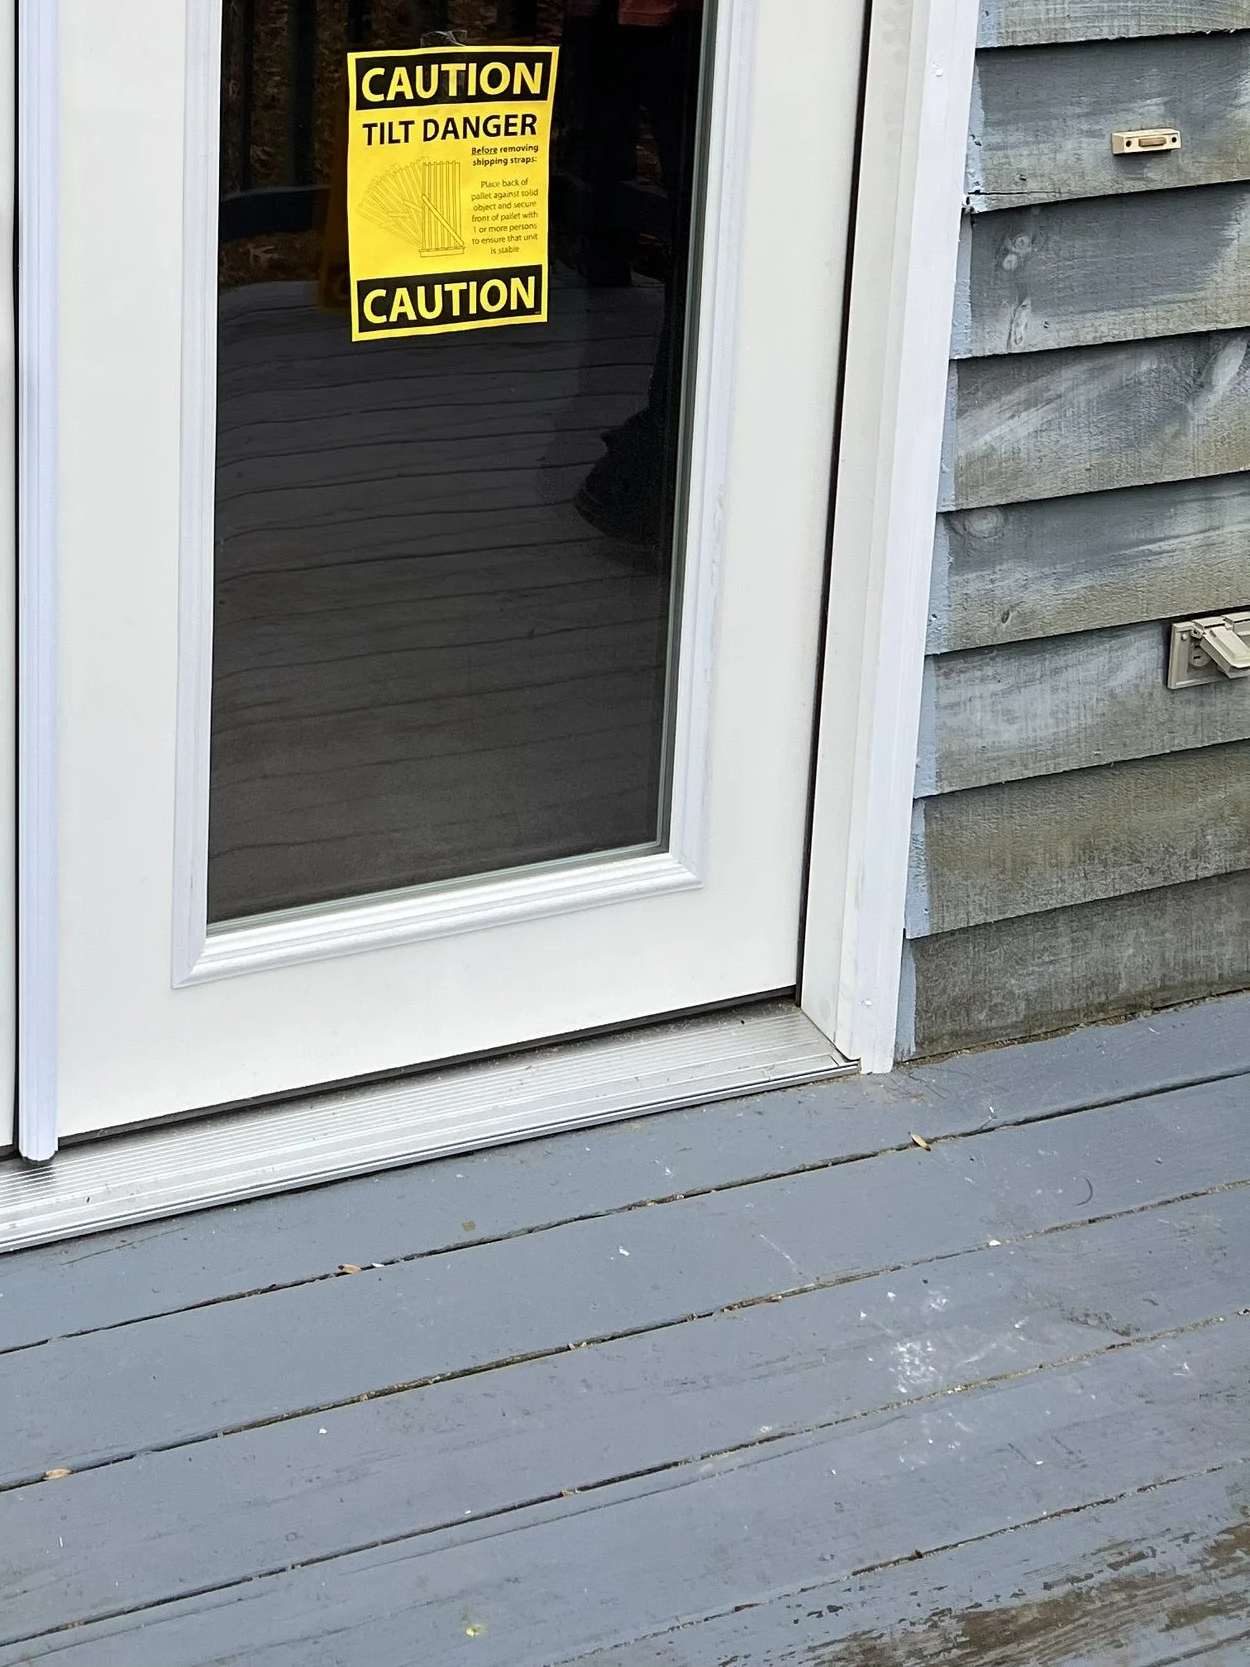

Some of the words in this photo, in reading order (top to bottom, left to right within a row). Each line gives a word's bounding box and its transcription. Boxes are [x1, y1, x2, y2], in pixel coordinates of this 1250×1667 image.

[361, 62, 543, 102] CAUTION
[362, 120, 415, 146] TILT
[423, 114, 537, 142] DANGER
[471, 146, 498, 156] Before
[500, 144, 539, 153] removing
[473, 158, 508, 167] shipping
[481, 180, 501, 188] Place
[502, 179, 519, 187] back
[471, 192, 491, 202] pallet
[494, 190, 520, 200] against
[521, 189, 538, 197] solid
[473, 204, 496, 212] object
[501, 212, 520, 222] pallet
[522, 211, 538, 219] with
[509, 223, 537, 232] persons
[481, 236, 505, 244] ensure
[507, 234, 522, 242] that
[363, 276, 535, 324] CAUTION
